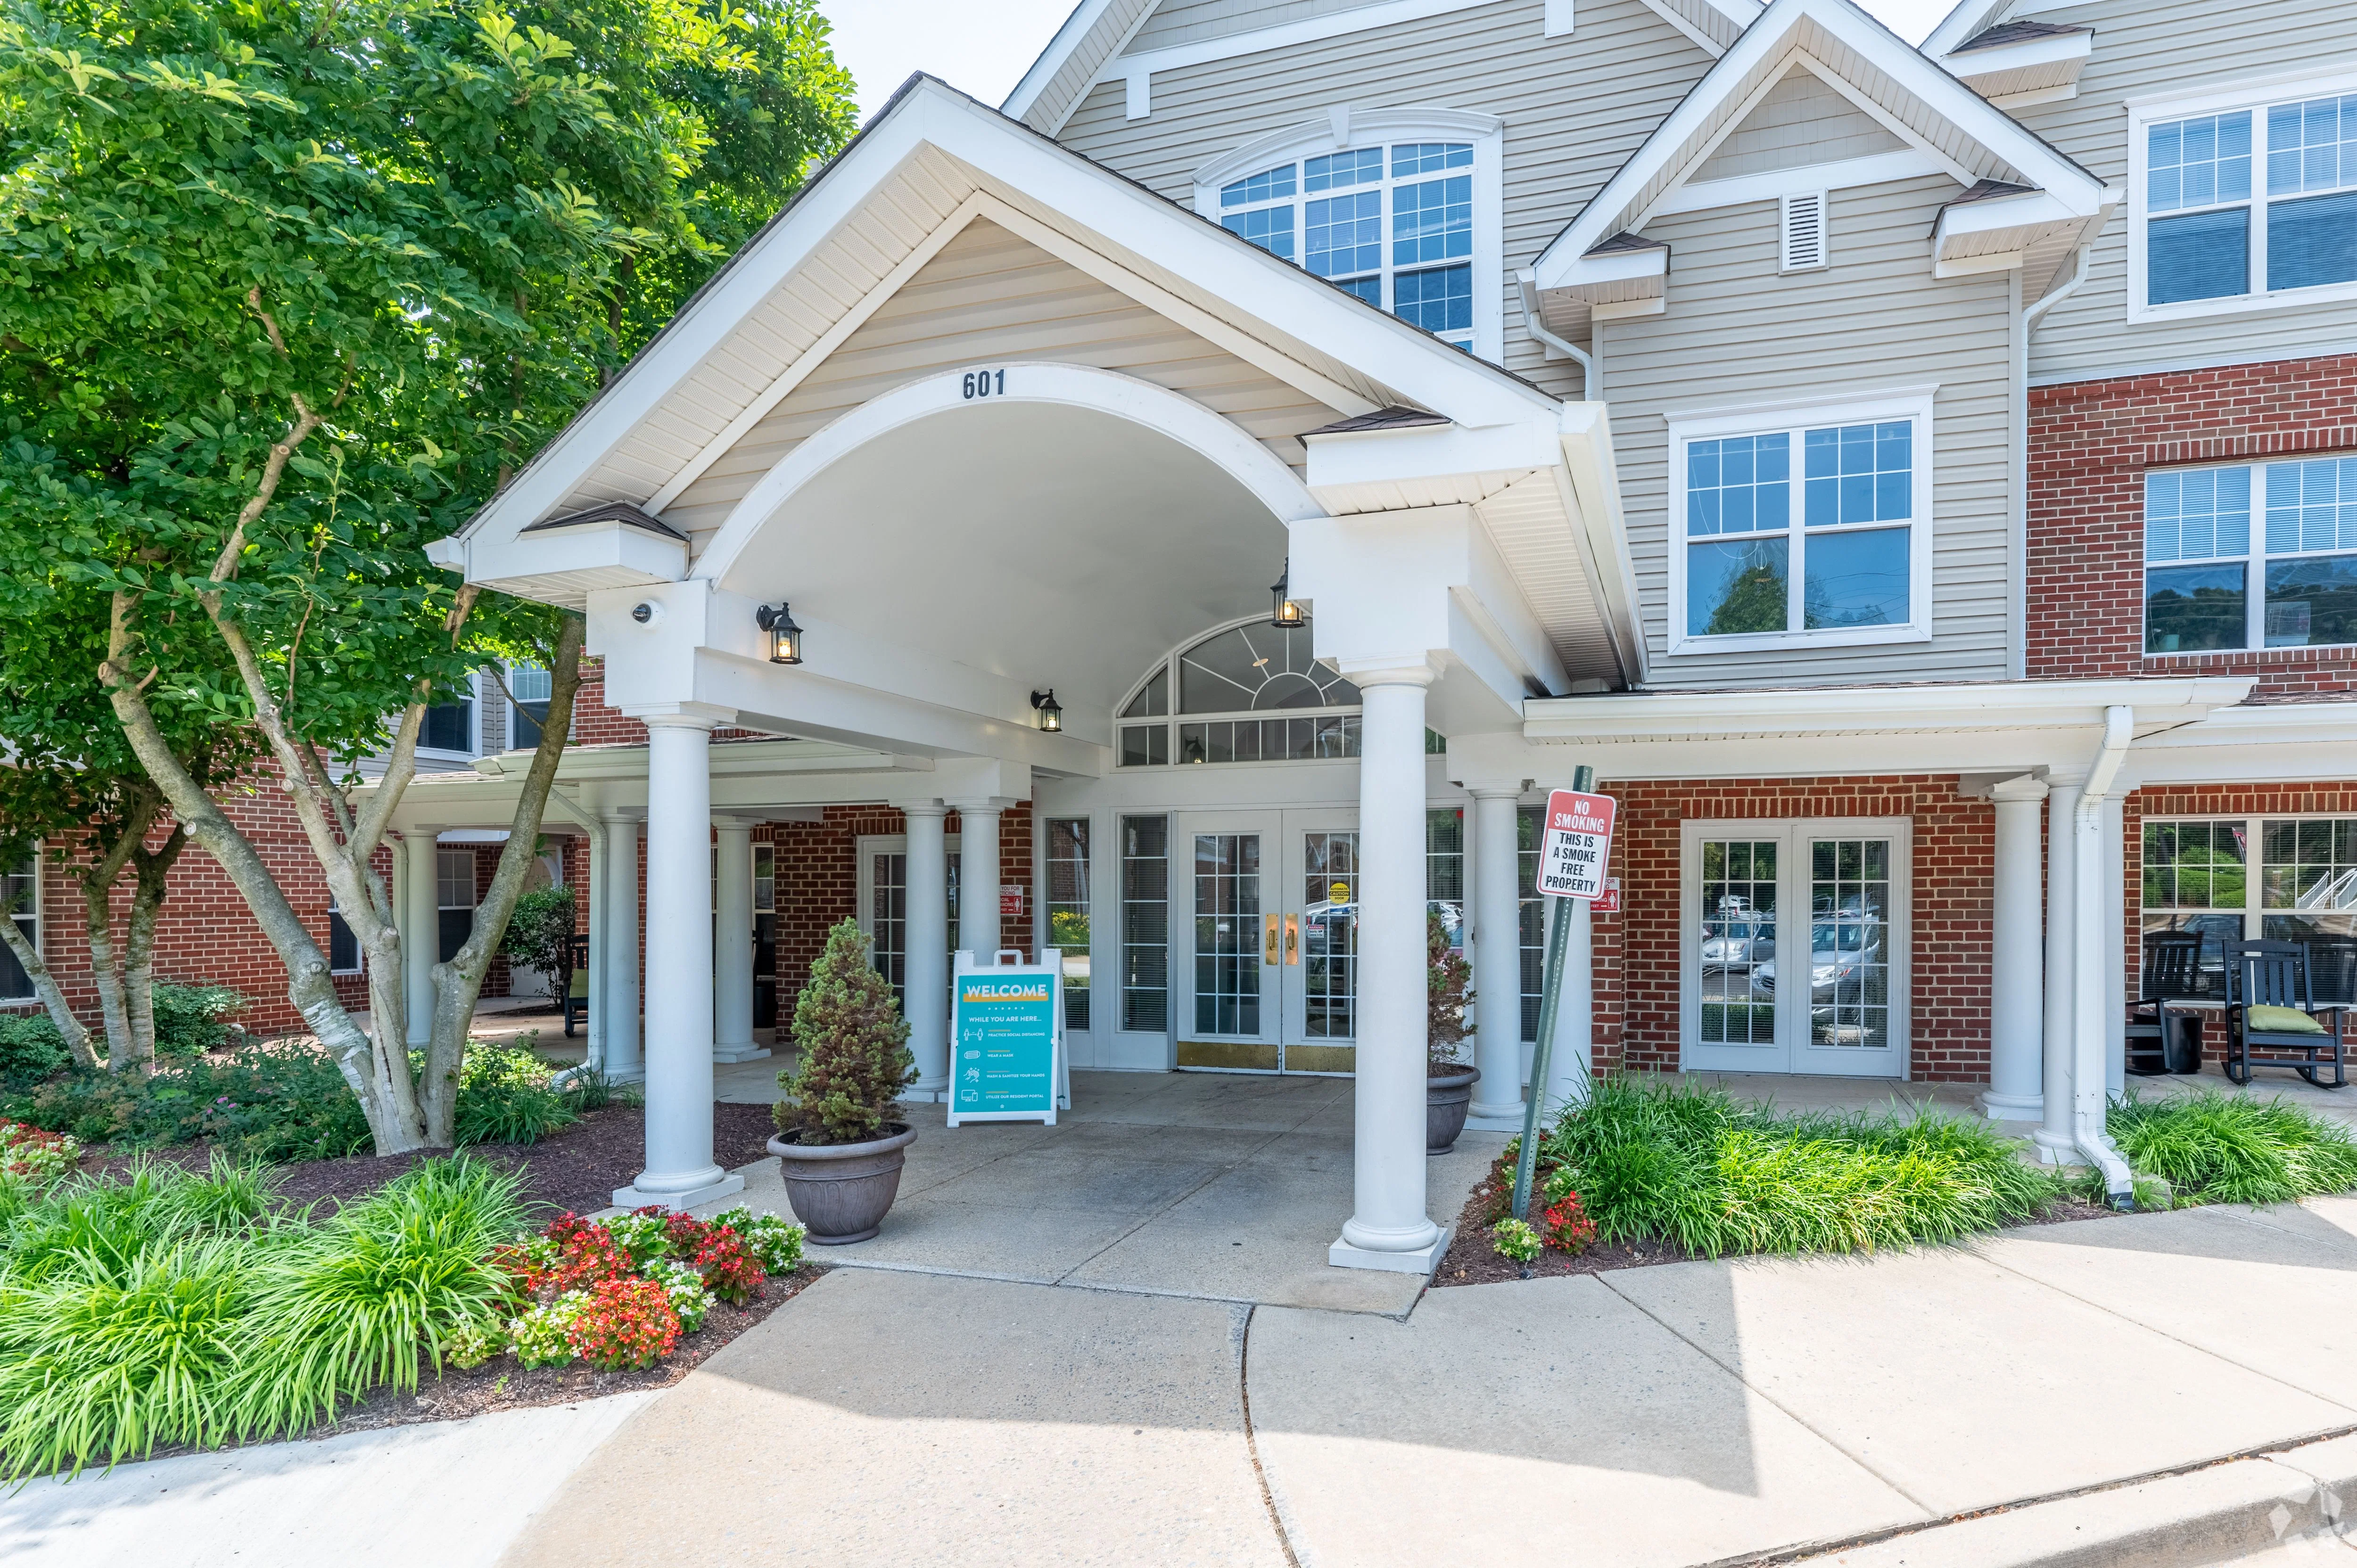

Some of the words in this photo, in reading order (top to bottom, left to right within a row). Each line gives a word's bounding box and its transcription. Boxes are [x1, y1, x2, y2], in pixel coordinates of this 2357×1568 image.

[964, 369, 1004, 399] 601
[1574, 800, 1590, 815] NO
[1554, 813, 1605, 832] SMOKING
[1559, 832, 1581, 846] THIS
[1583, 836, 1594, 847] IS
[1552, 847, 1559, 858] A
[1562, 848, 1596, 862] SMOKE
[1560, 862, 1585, 876] FREE
[1545, 875, 1596, 892] PROPERTY
[966, 984, 1046, 998] WELCOME
